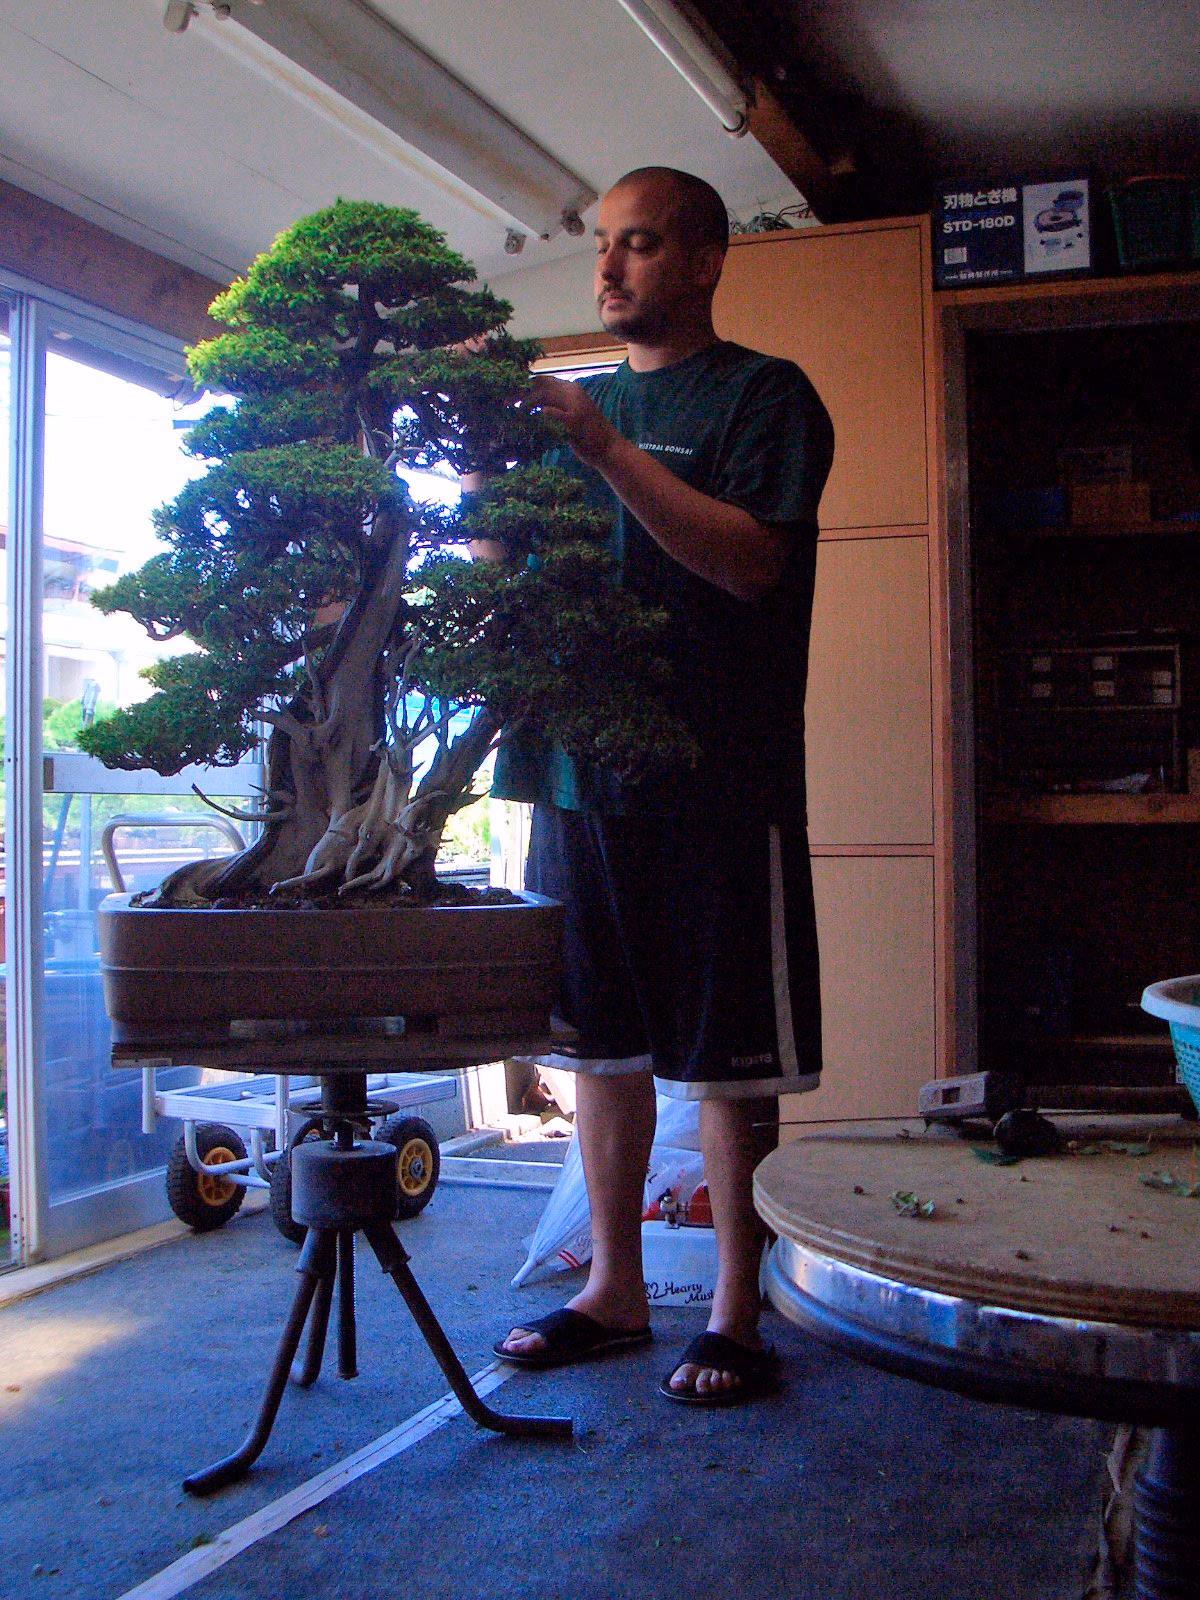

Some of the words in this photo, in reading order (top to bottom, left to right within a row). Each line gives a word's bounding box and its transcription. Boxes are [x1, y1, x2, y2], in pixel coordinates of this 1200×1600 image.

[943, 187, 1017, 209] 刃物とぎ機
[943, 215, 1015, 234] STD-180D
[665, 445, 693, 455] BONSAI
[664, 1281, 703, 1295] Hearty
